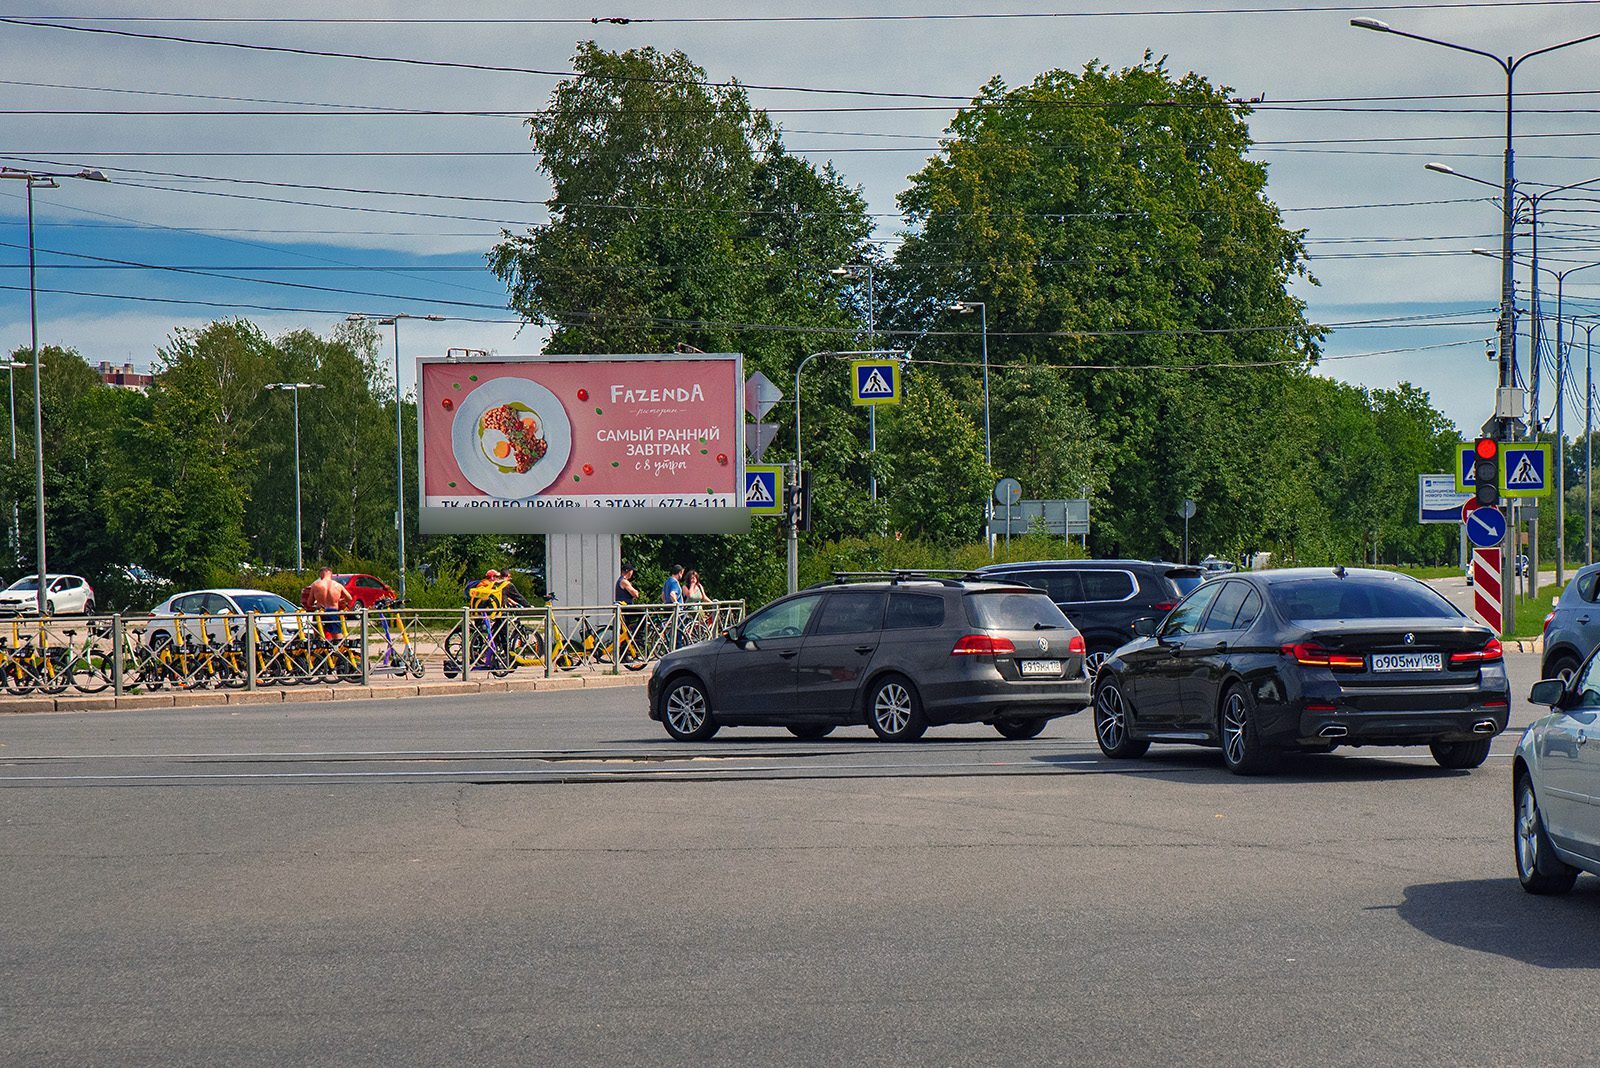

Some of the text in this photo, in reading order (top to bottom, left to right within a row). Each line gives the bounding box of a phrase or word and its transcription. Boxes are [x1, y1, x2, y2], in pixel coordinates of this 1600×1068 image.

[610, 383, 705, 403] FAZENDA
[596, 425, 720, 442] САМЫЙ РАННИЙ
[626, 443, 691, 456] ЗАВТРАК
[635, 459, 687, 477] с 8 утра
